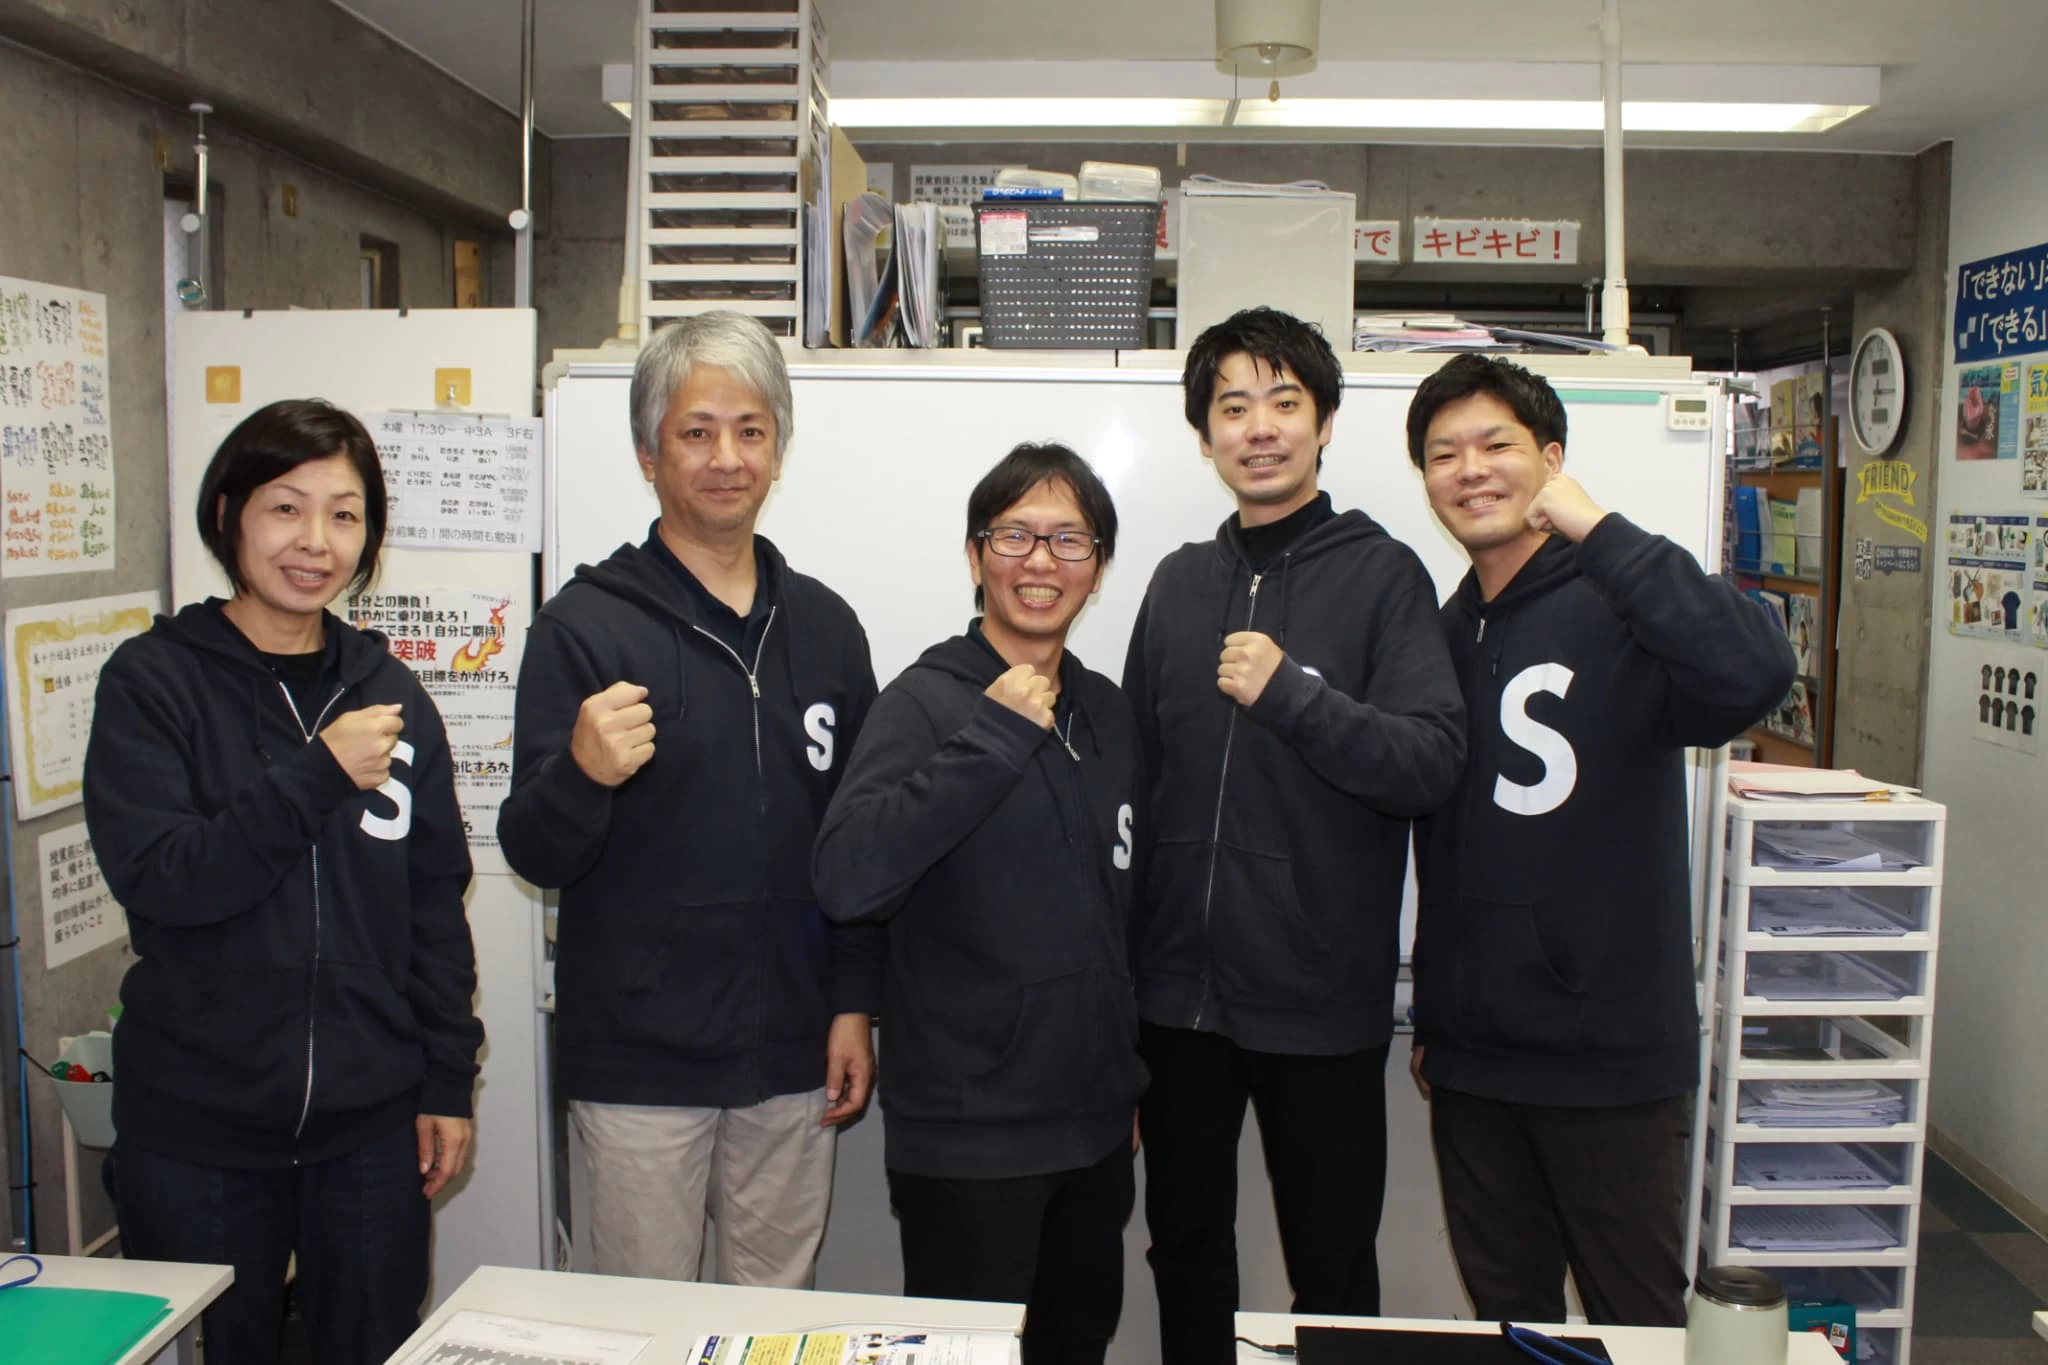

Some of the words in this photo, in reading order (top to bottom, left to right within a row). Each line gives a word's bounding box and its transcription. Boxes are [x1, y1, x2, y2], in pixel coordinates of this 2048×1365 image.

[1354, 229, 1392, 256] で
[1422, 228, 1561, 260] キビキビ！
[1962, 259, 2048, 301] 「できない」
[1863, 462, 1910, 494] FRIEND
[387, 640, 437, 661] 突破
[803, 702, 836, 772] S
[1493, 662, 1577, 816] S
[1112, 803, 1133, 870] S
